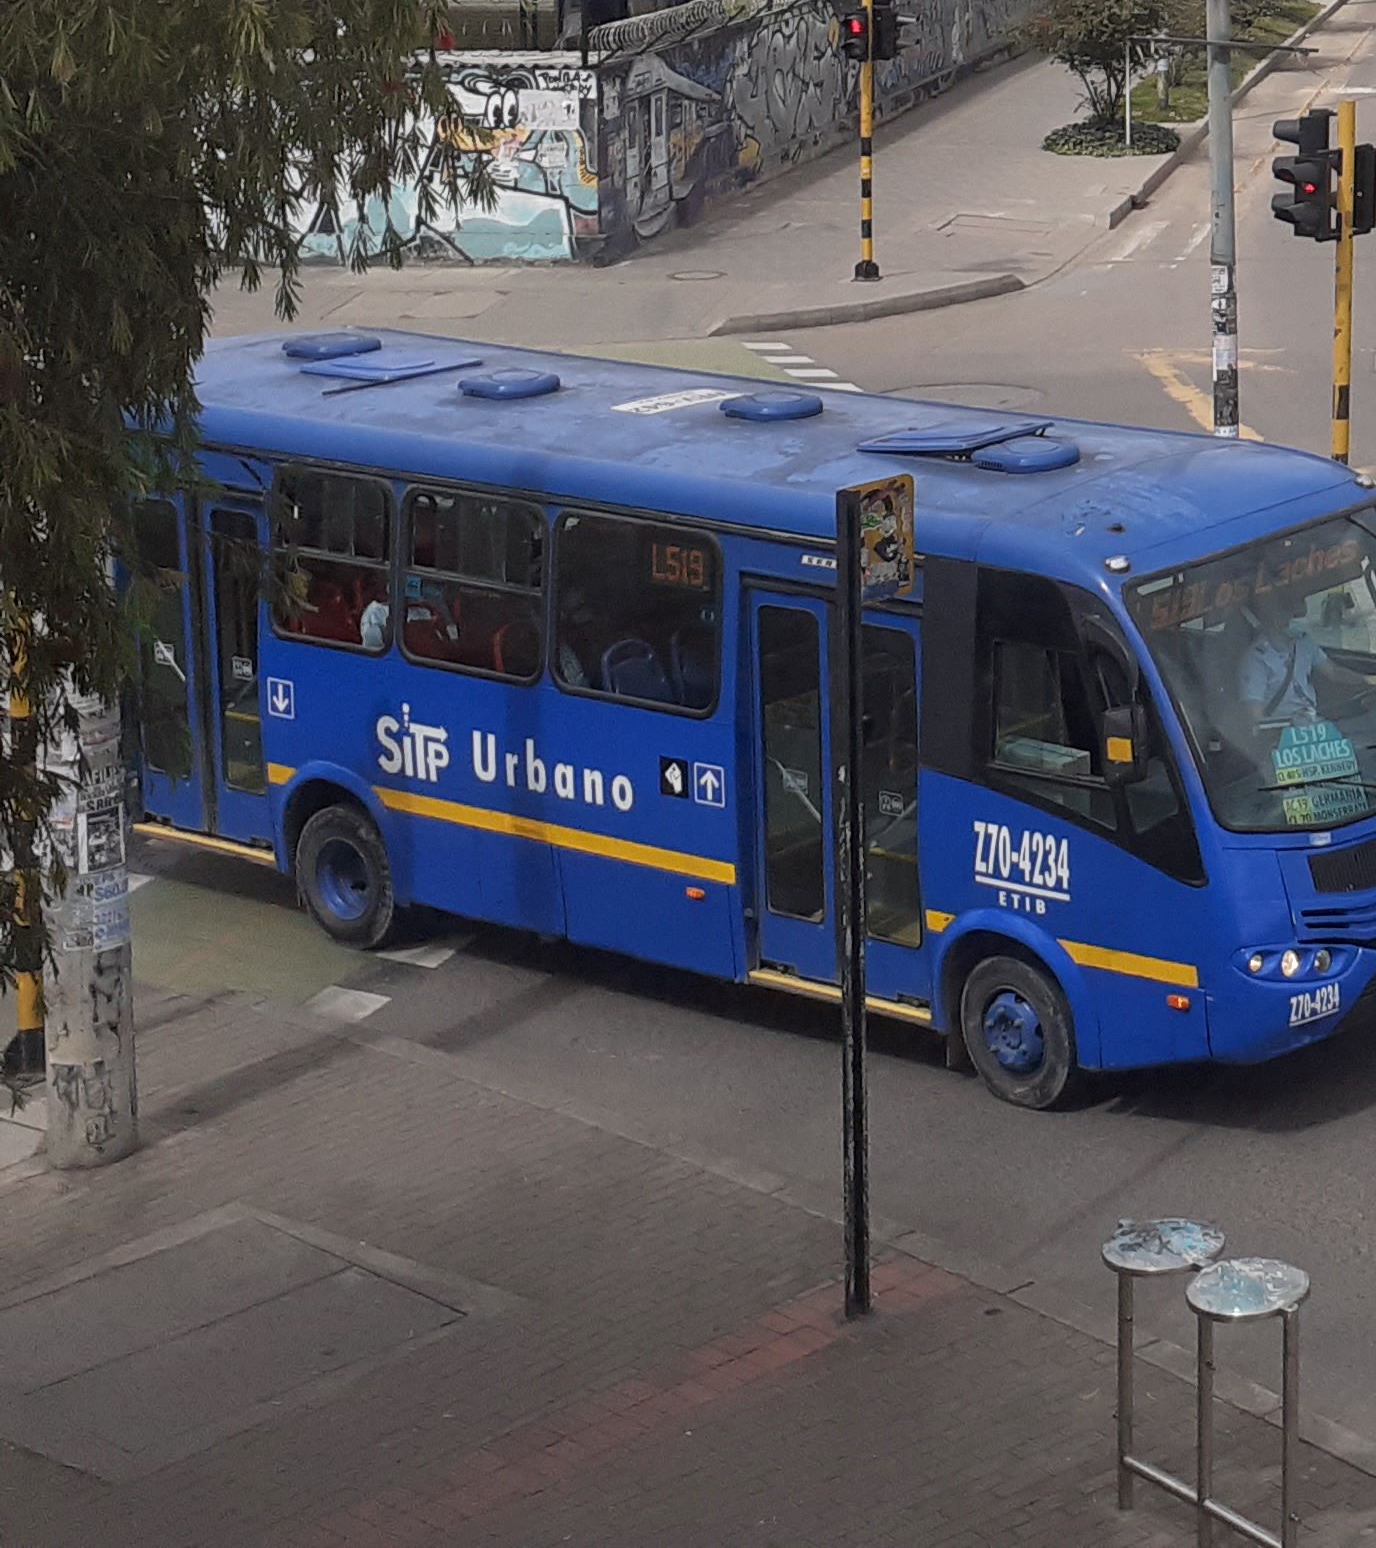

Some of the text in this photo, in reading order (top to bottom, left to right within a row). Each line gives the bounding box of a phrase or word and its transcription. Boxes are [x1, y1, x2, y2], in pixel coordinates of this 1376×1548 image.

[1291, 723, 1327, 745] L519
[472, 729, 634, 811] Urbano
[1275, 738, 1351, 768] LOS LACHES
[973, 820, 1070, 890] Z70-4234
[998, 890, 1047, 915] ETIB
[1289, 981, 1341, 1023] Z70-4234
